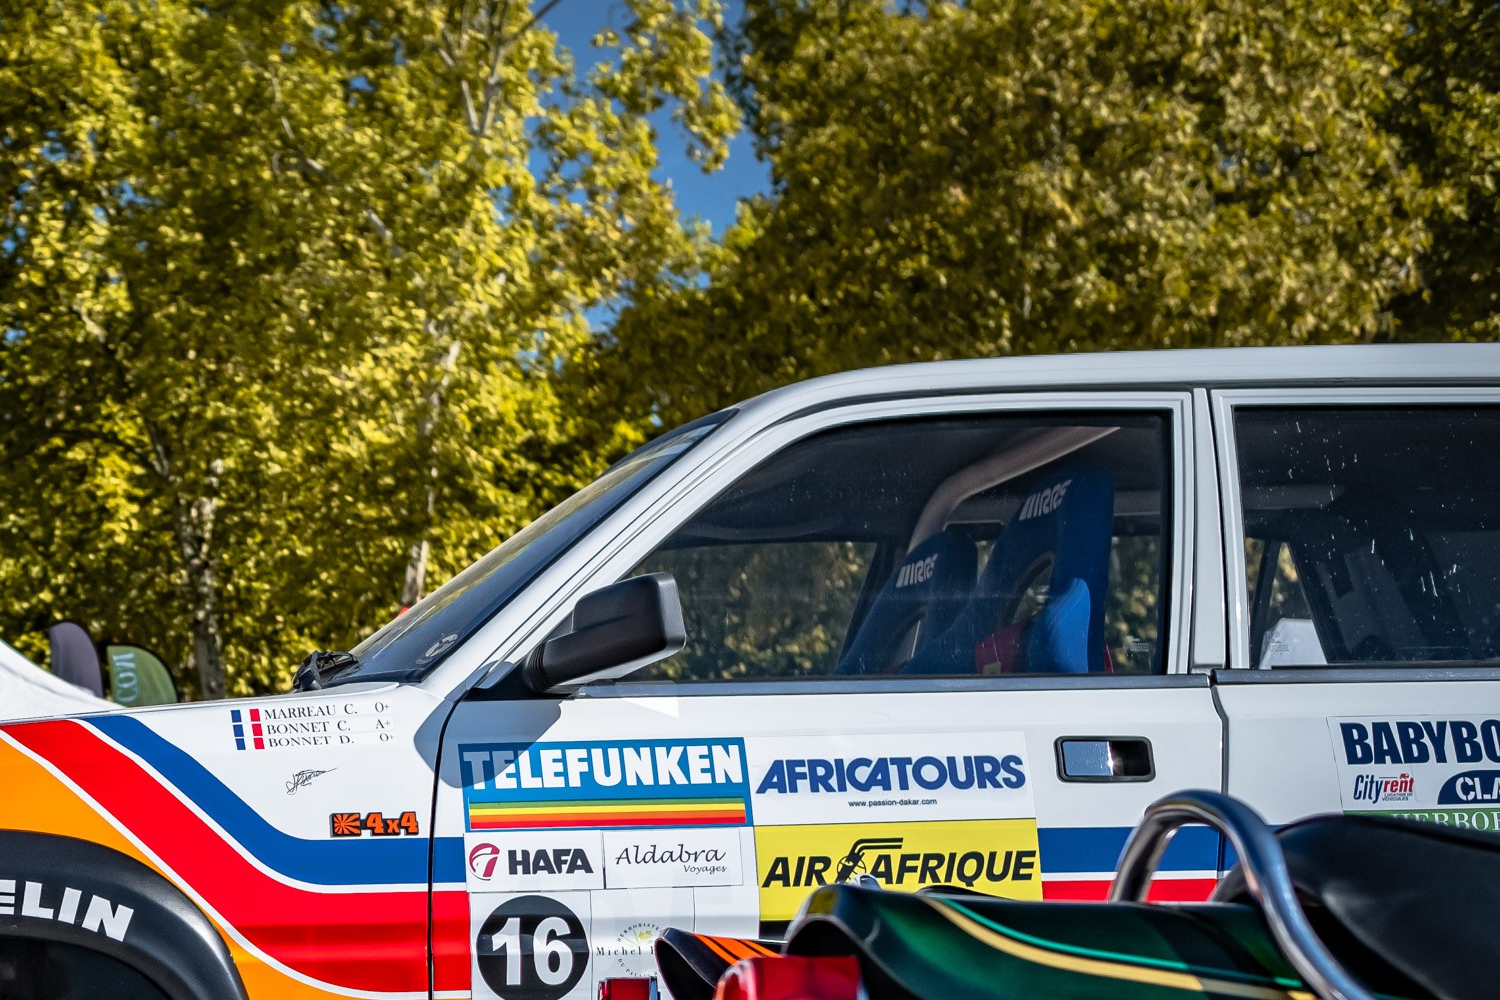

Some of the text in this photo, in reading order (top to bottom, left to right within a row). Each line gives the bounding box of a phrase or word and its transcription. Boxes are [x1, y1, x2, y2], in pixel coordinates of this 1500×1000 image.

[264, 705, 336, 720] MARREAU
[344, 703, 358, 715] C.
[267, 719, 391, 735] BONNET C. A+
[268, 736, 331, 748] BONNET
[339, 735, 355, 745] D.
[463, 745, 744, 790] TELEFUNKEN
[756, 755, 1026, 794] AFRICATOURS
[848, 799, 938, 808] www.passion-dakar.com
[366, 812, 419, 835] 4x4
[508, 848, 594, 875] HAFA
[615, 843, 726, 865] Aldabra
[683, 864, 727, 874] Voyages
[762, 851, 1036, 888] AIR AFRIQUE
[492, 917, 573, 986] 16
[596, 946, 642, 956] Michel
